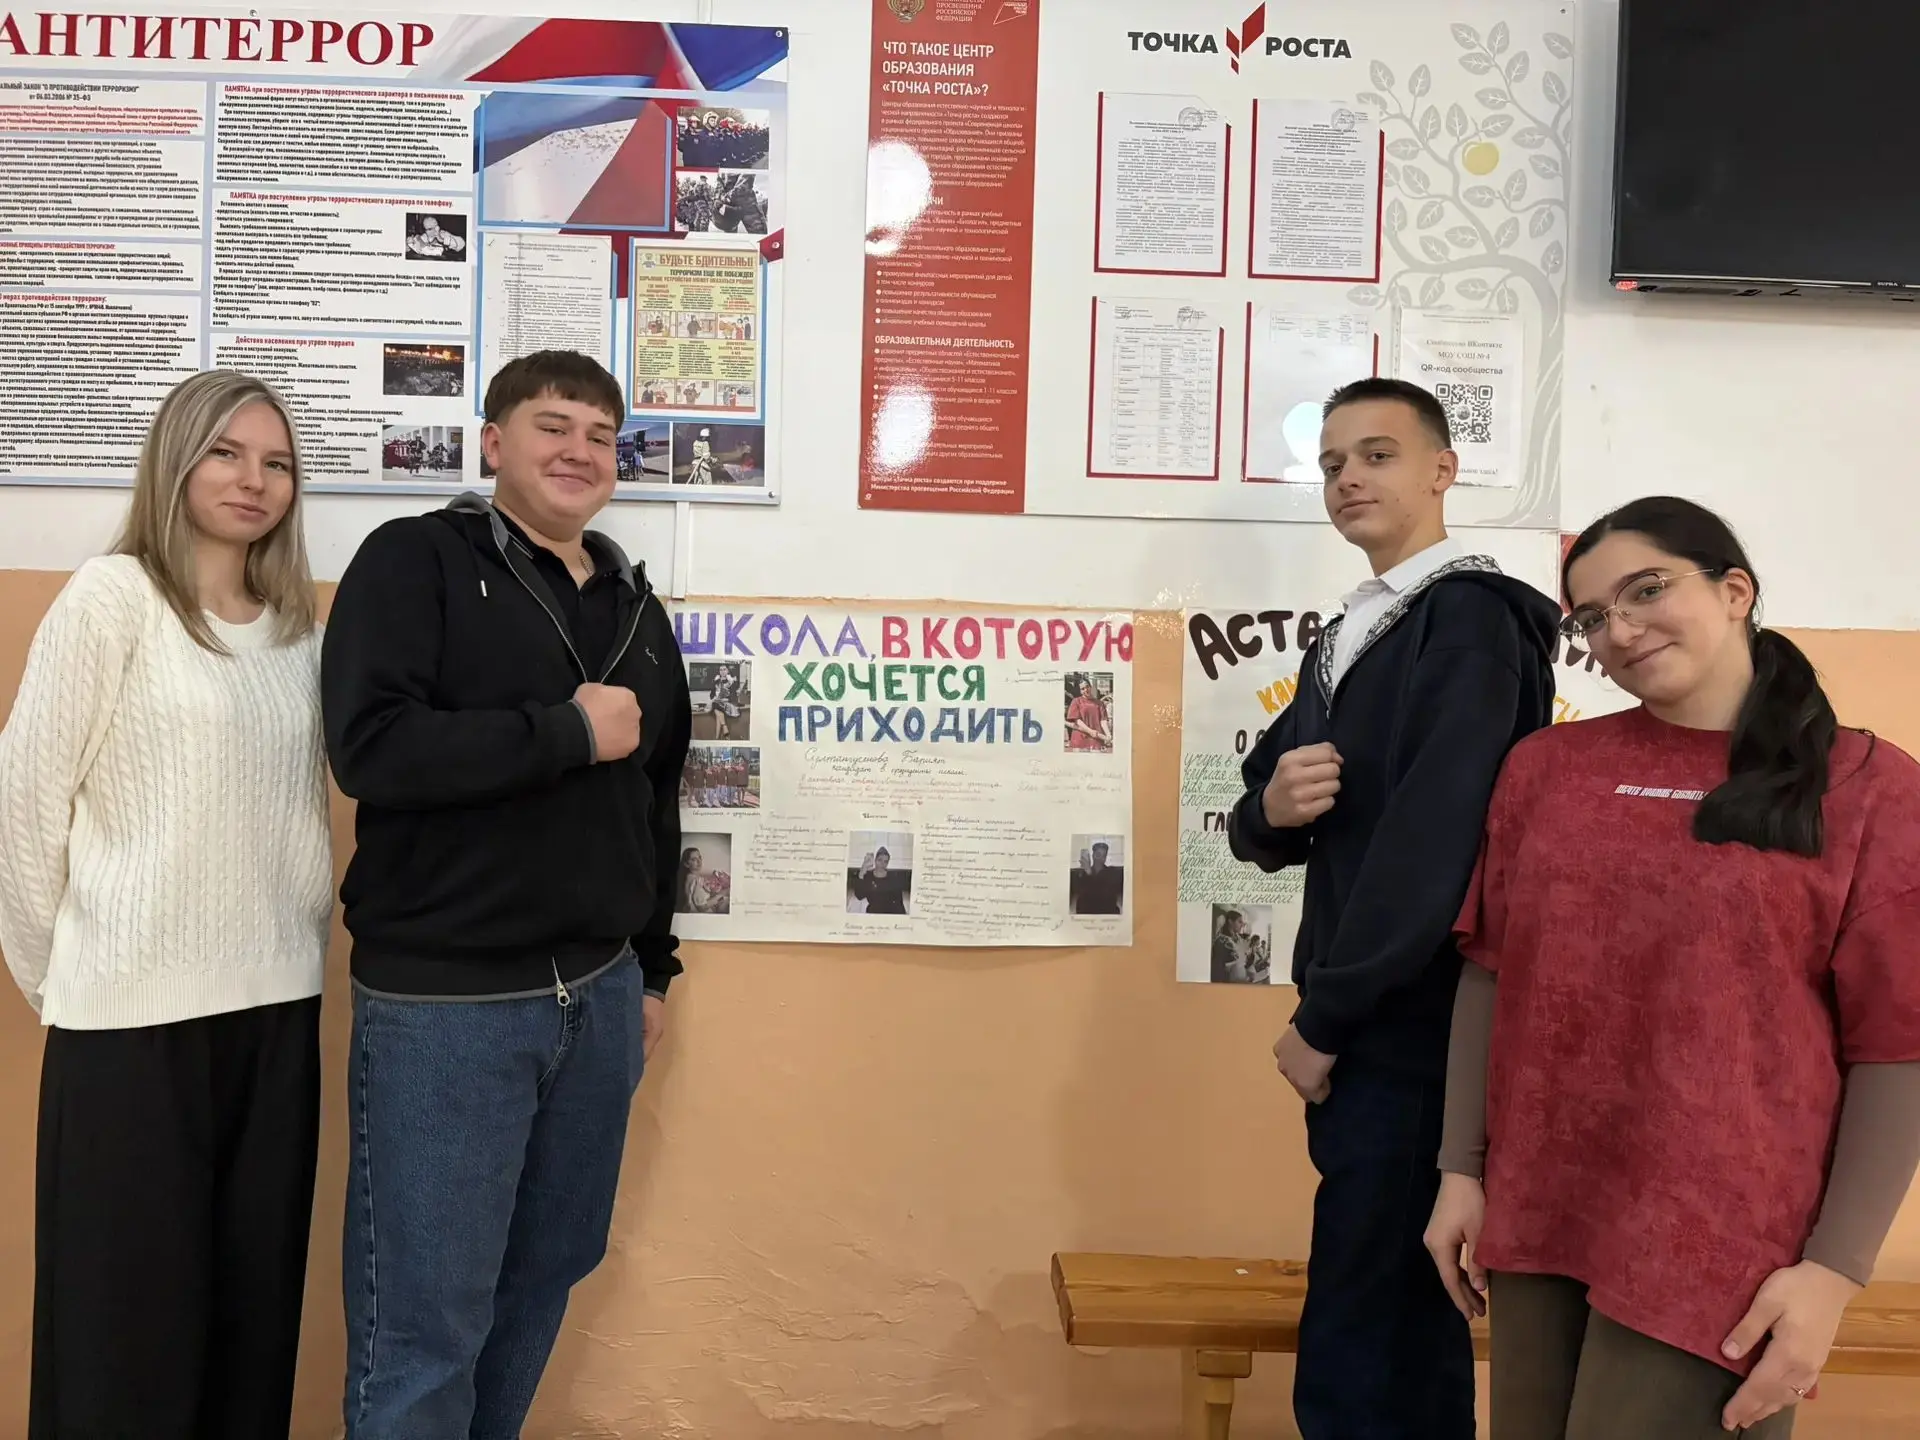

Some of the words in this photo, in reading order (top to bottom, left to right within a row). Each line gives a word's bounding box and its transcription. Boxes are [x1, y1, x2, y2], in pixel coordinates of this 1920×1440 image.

[0, 12, 434, 66] АНТИТЕРРОР
[1128, 32, 1218, 54] ТОЧКА
[1266, 37, 1352, 59] РОСТА
[884, 42, 906, 54] ЧТО
[910, 42, 950, 56] ТАКОЕ
[954, 44, 994, 58] ЦЕНТР
[882, 61, 974, 76] ОБРАЗОВАНИЯ
[0, 82, 22, 90] АЛЬНЫЙ
[882, 80, 930, 94] «ТОЧКА
[934, 82, 989, 96] РОСТА»?
[660, 254, 694, 266] БУДЬТЕ
[875, 336, 951, 346] ОБРАЗОВАТЕЛЬНАЯ
[952, 338, 1015, 349] ДЕЯТЕЛЬНОСТЬ
[1421, 364, 1450, 373] QR-код
[1453, 366, 1503, 375] сообщества
[674, 612, 876, 661] ШКОЛА,
[882, 616, 910, 658] В
[922, 617, 1133, 662] КОТОРУЮ
[1189, 611, 1324, 680] АСТА
[782, 661, 985, 701] ХОЧЕТСЯ
[778, 705, 1043, 744] ПРИХОДИТЬ
